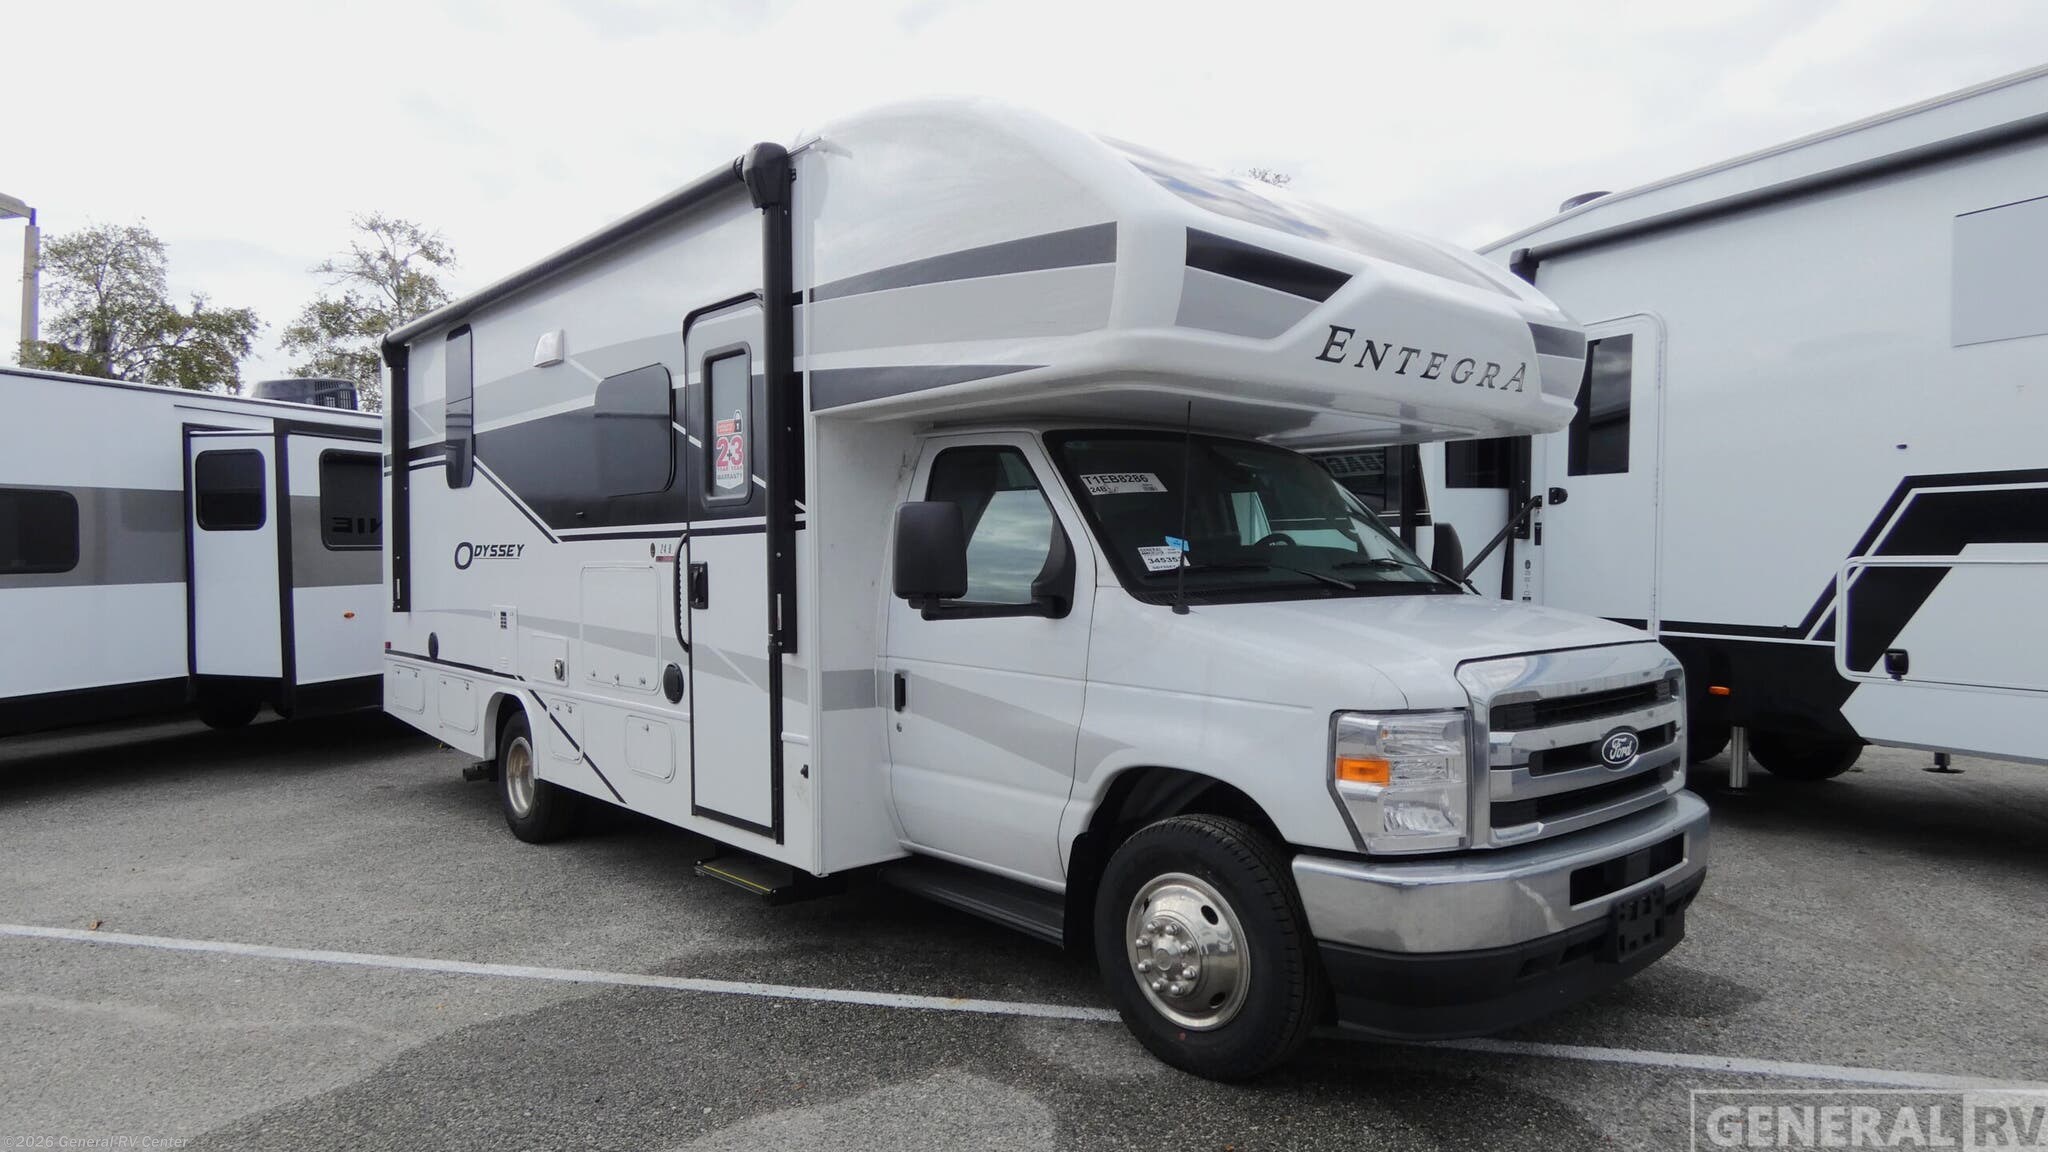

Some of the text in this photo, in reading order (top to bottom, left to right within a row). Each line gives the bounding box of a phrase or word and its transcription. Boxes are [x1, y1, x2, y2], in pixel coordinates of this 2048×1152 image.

[1315, 324, 1528, 393] ENTEGRA
[454, 541, 525, 571] ODYSSEY
[1609, 737, 1633, 760] Ford
